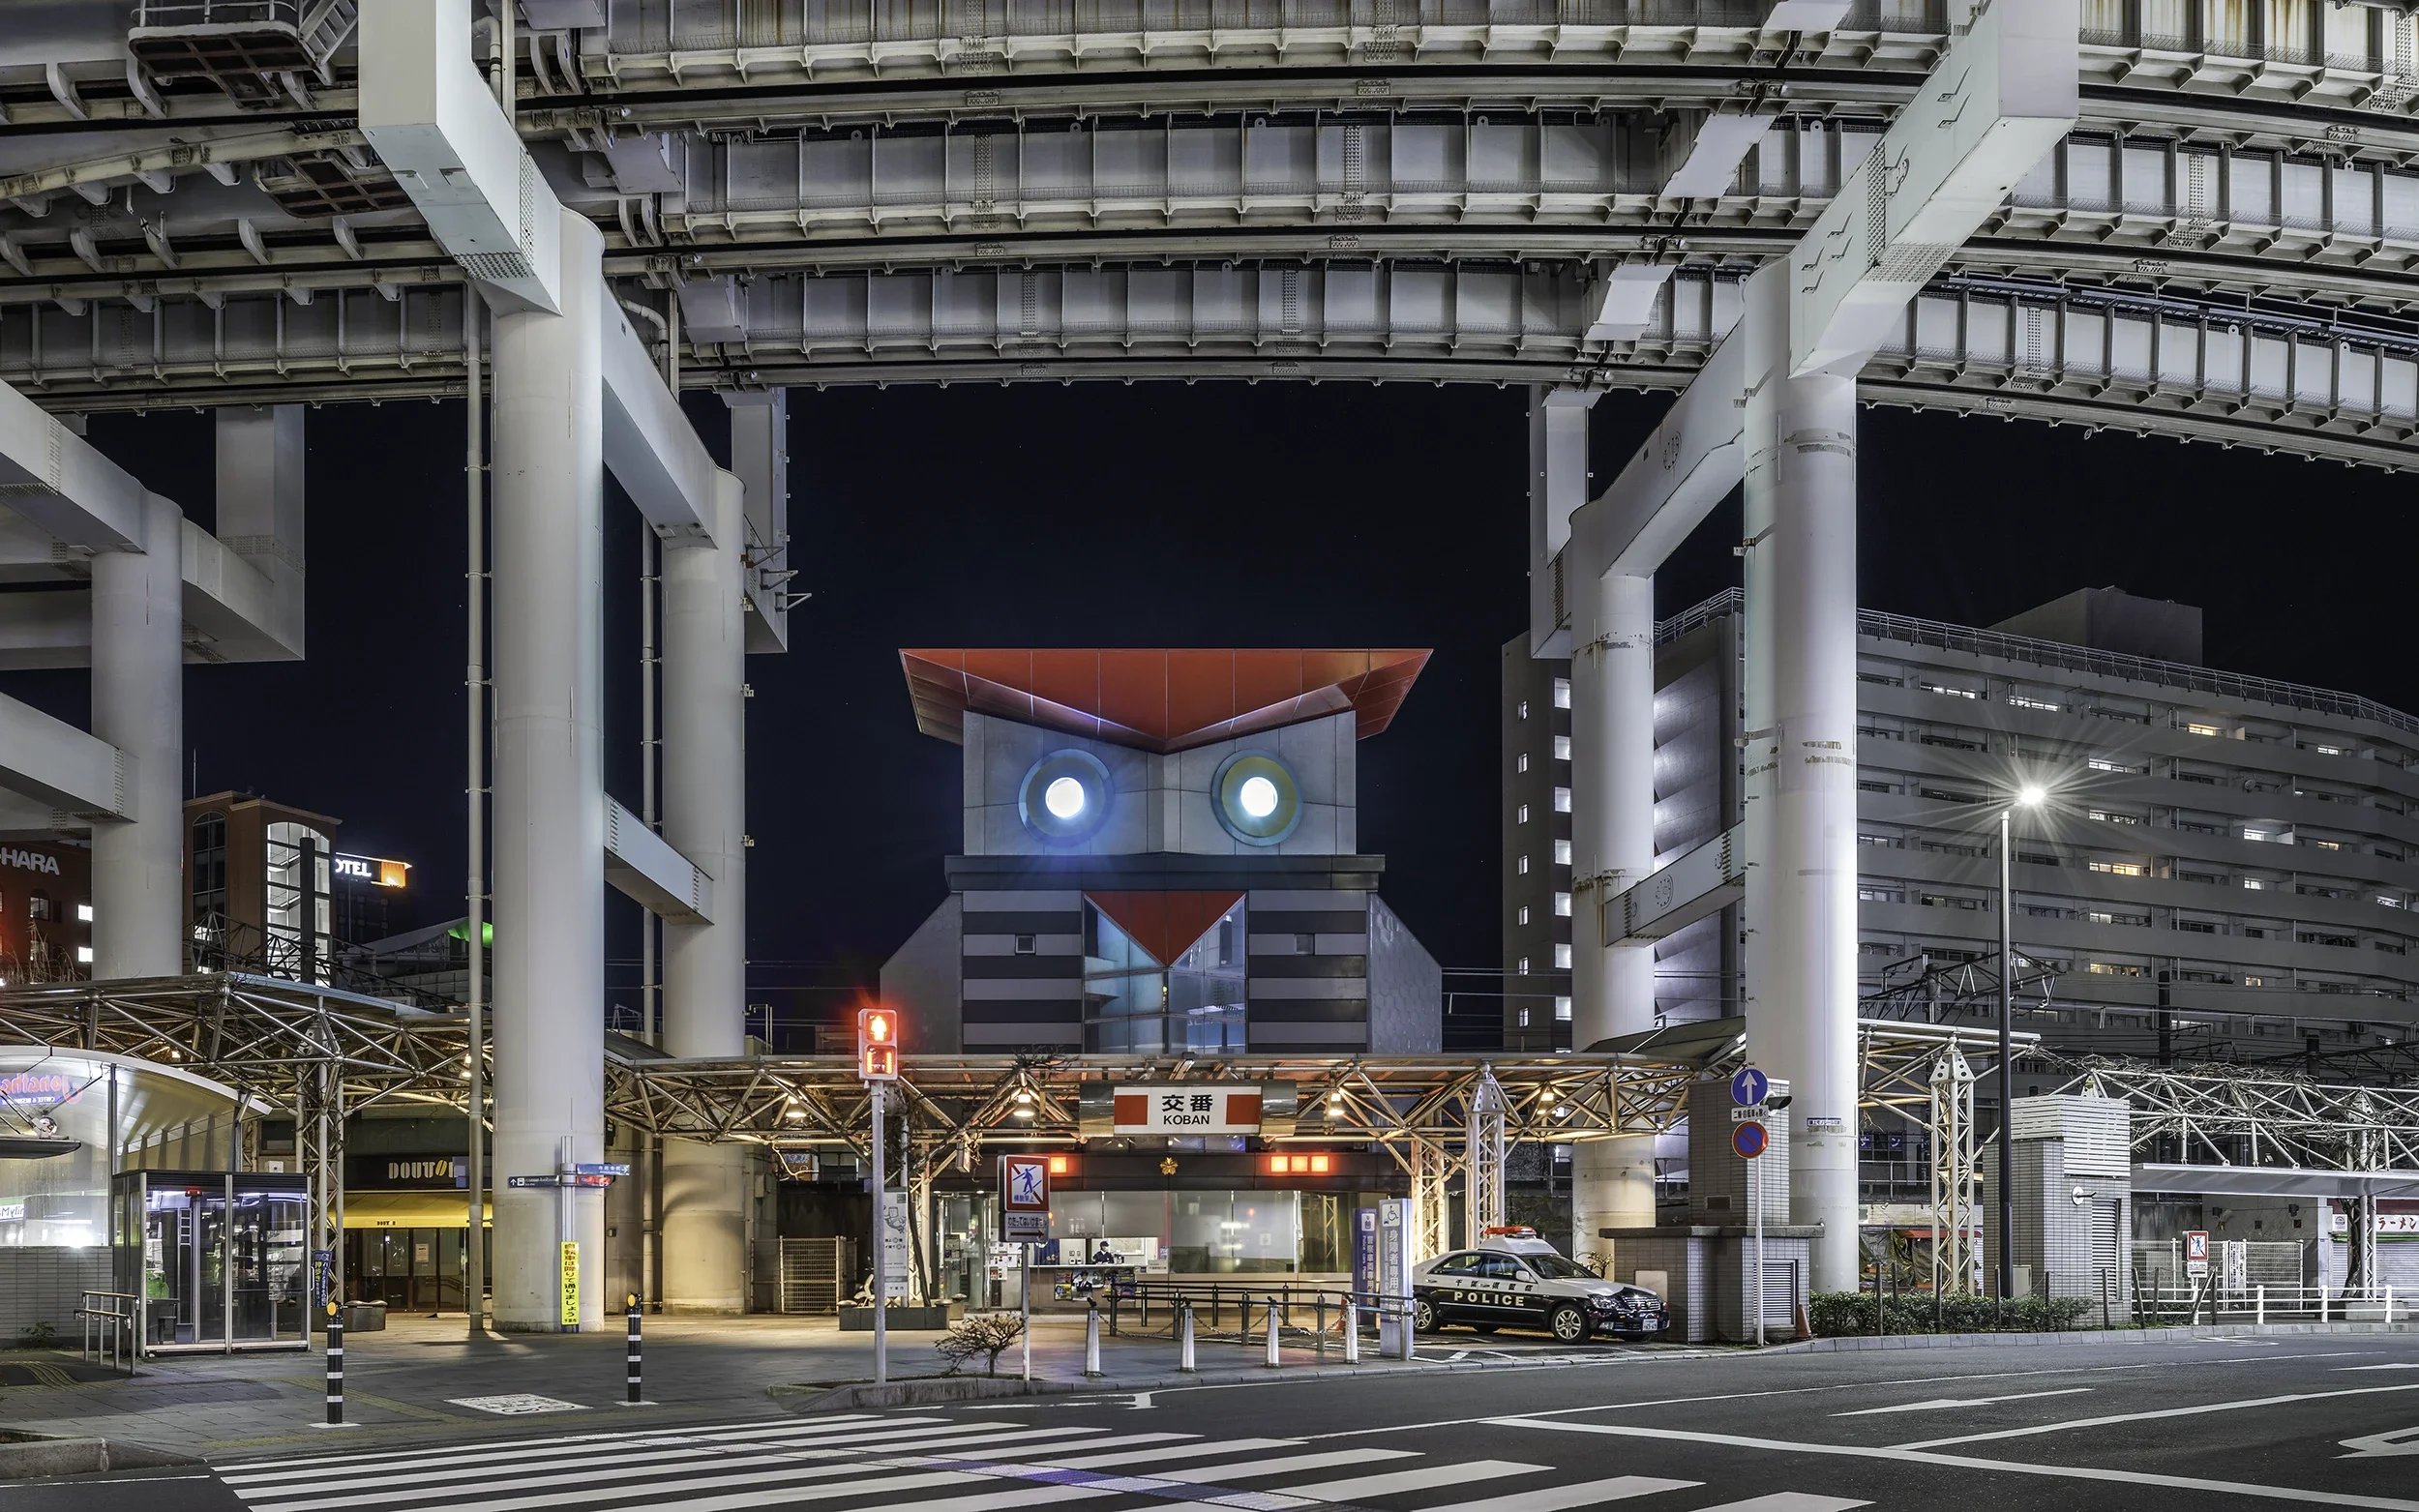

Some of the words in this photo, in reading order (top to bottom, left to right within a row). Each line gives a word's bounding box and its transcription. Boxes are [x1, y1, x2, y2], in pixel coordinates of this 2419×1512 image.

[1161, 1094, 1213, 1112] 交番
[1163, 1114, 1210, 1125] KOBAN
[2377, 1217, 2418, 1230] ラーメン
[1453, 1291, 1525, 1307] POLICE
